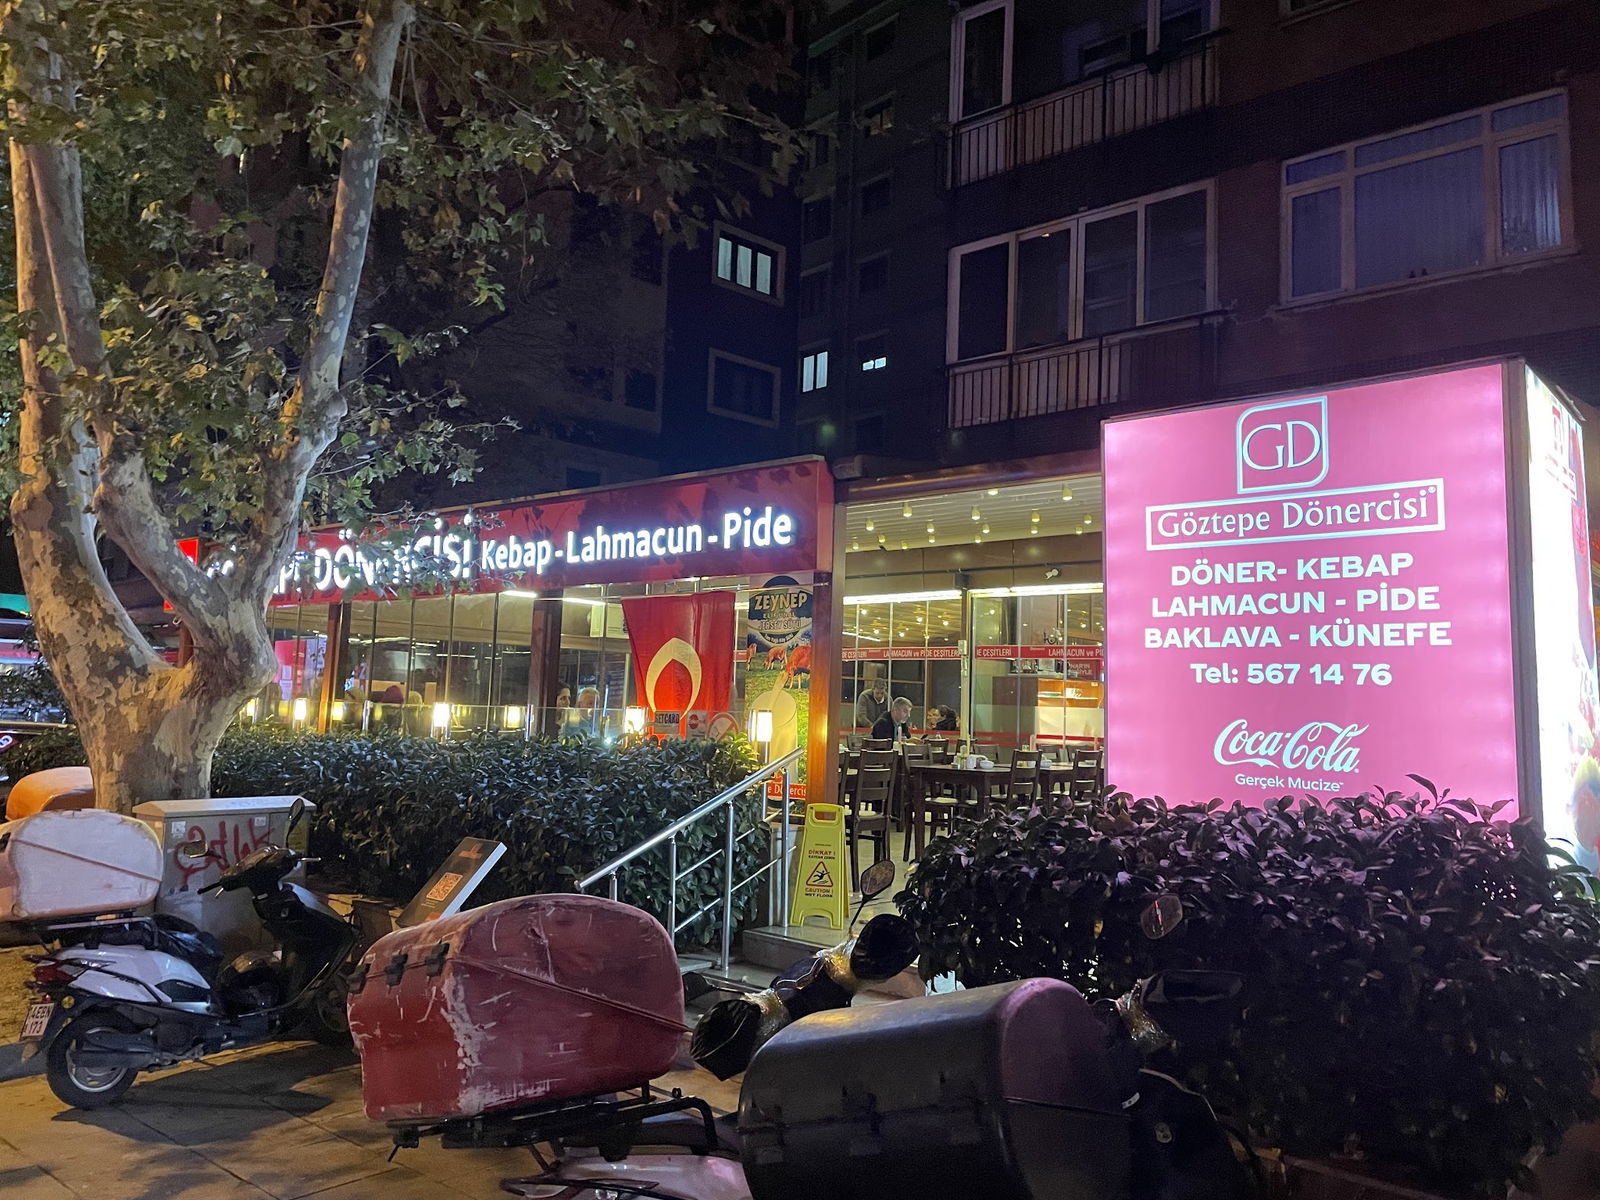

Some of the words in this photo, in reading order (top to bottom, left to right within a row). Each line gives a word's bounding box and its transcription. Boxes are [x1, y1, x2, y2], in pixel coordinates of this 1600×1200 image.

[1242, 420, 1321, 471] GD
[1157, 511, 1270, 538] Göztepe
[1282, 489, 1428, 530] Dönercisi
[481, 535, 552, 575] Kebap
[566, 525, 703, 564] Lahmacun
[723, 506, 792, 549] Pide
[1296, 552, 1414, 581] KEBAP
[754, 592, 808, 611] ZEYNEP
[1151, 591, 1325, 618] LAHMACUN
[1356, 581, 1441, 611] PİDE
[1144, 627, 1281, 649] BAKLAVA
[1309, 618, 1453, 648] KÜNEFE
[1190, 663, 1238, 684] Tel:
[1247, 663, 1300, 684] 567
[1309, 663, 1344, 685] 14
[1352, 663, 1393, 686] 76
[1213, 718, 1369, 773] Coca-Cola
[1234, 773, 1285, 790] Gerçek
[1288, 776, 1341, 792] Mucize
